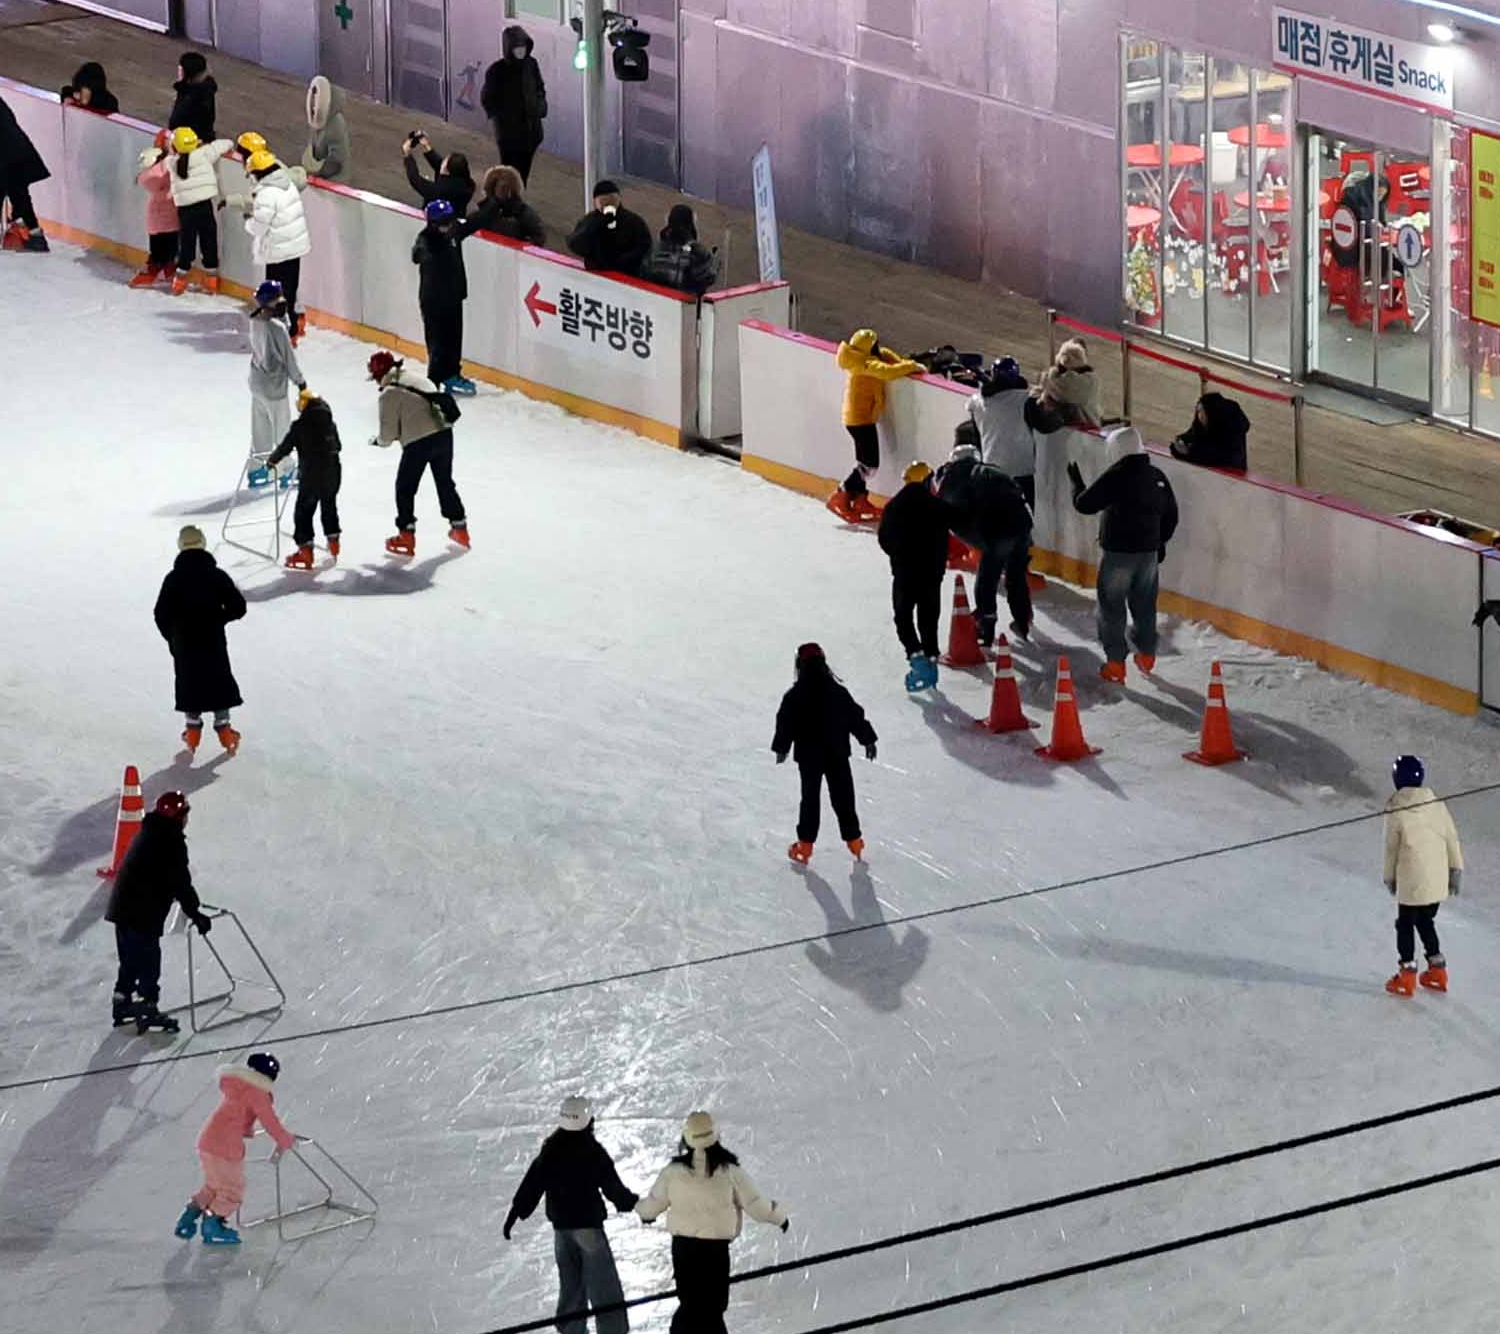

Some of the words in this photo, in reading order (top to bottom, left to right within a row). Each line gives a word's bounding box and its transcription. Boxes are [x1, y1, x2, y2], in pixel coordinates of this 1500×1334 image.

[1278, 16, 1394, 87] 매점/휴게실
[1398, 60, 1447, 94] Snack
[558, 287, 653, 359] 활주방향
